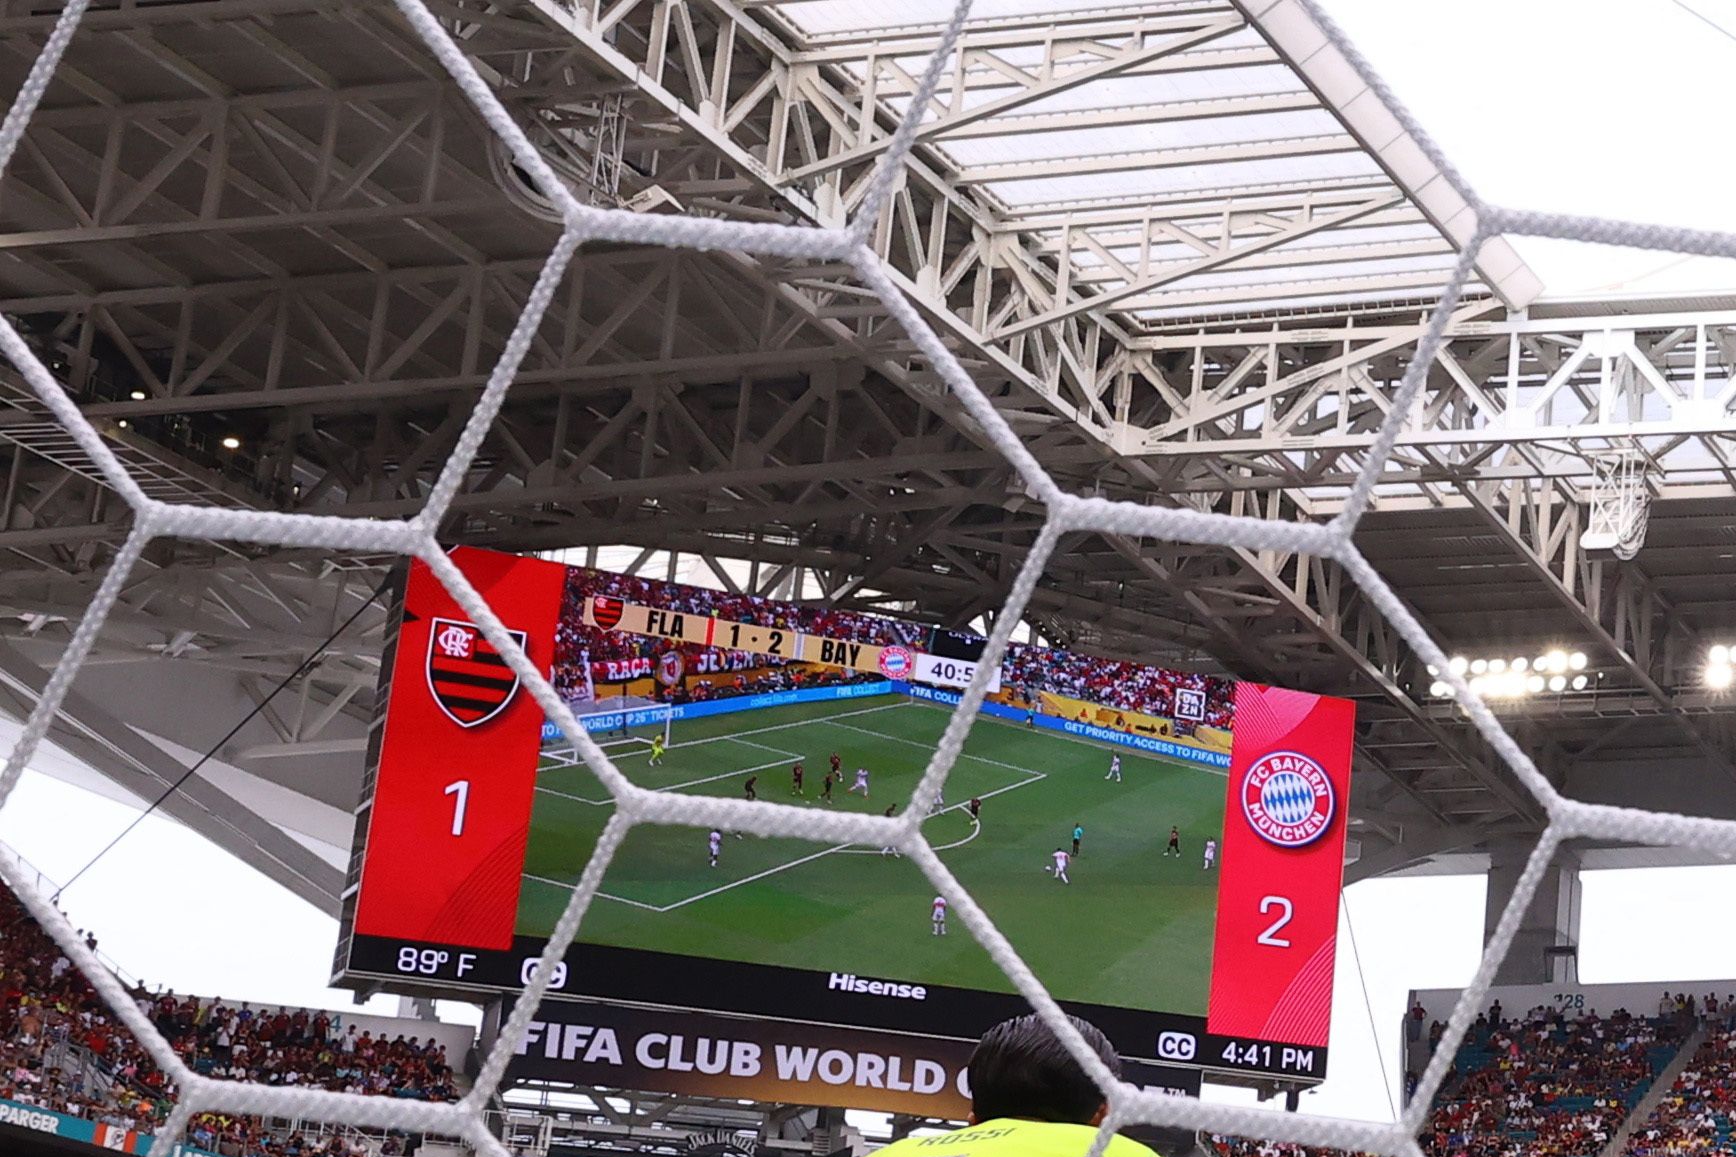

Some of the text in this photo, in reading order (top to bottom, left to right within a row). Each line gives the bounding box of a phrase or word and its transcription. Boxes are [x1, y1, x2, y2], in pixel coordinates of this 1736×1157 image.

[647, 610, 684, 639] FLA
[820, 639, 861, 667] BAY
[931, 662, 976, 683] 40:5
[1270, 756, 1327, 797] BAYERN
[443, 780, 469, 836] 1
[1249, 802, 1328, 841] MÜNCHEN
[1257, 895, 1294, 947] 2
[456, 954, 477, 977] F
[828, 972, 928, 1001] Hisense
[516, 1020, 624, 1067] FIFA
[635, 1032, 761, 1077] CLUB
[773, 1044, 947, 1095] WORLD
[1222, 1040, 1313, 1072] 4:41 PM
[917, 1126, 1017, 1148] ROSSI
